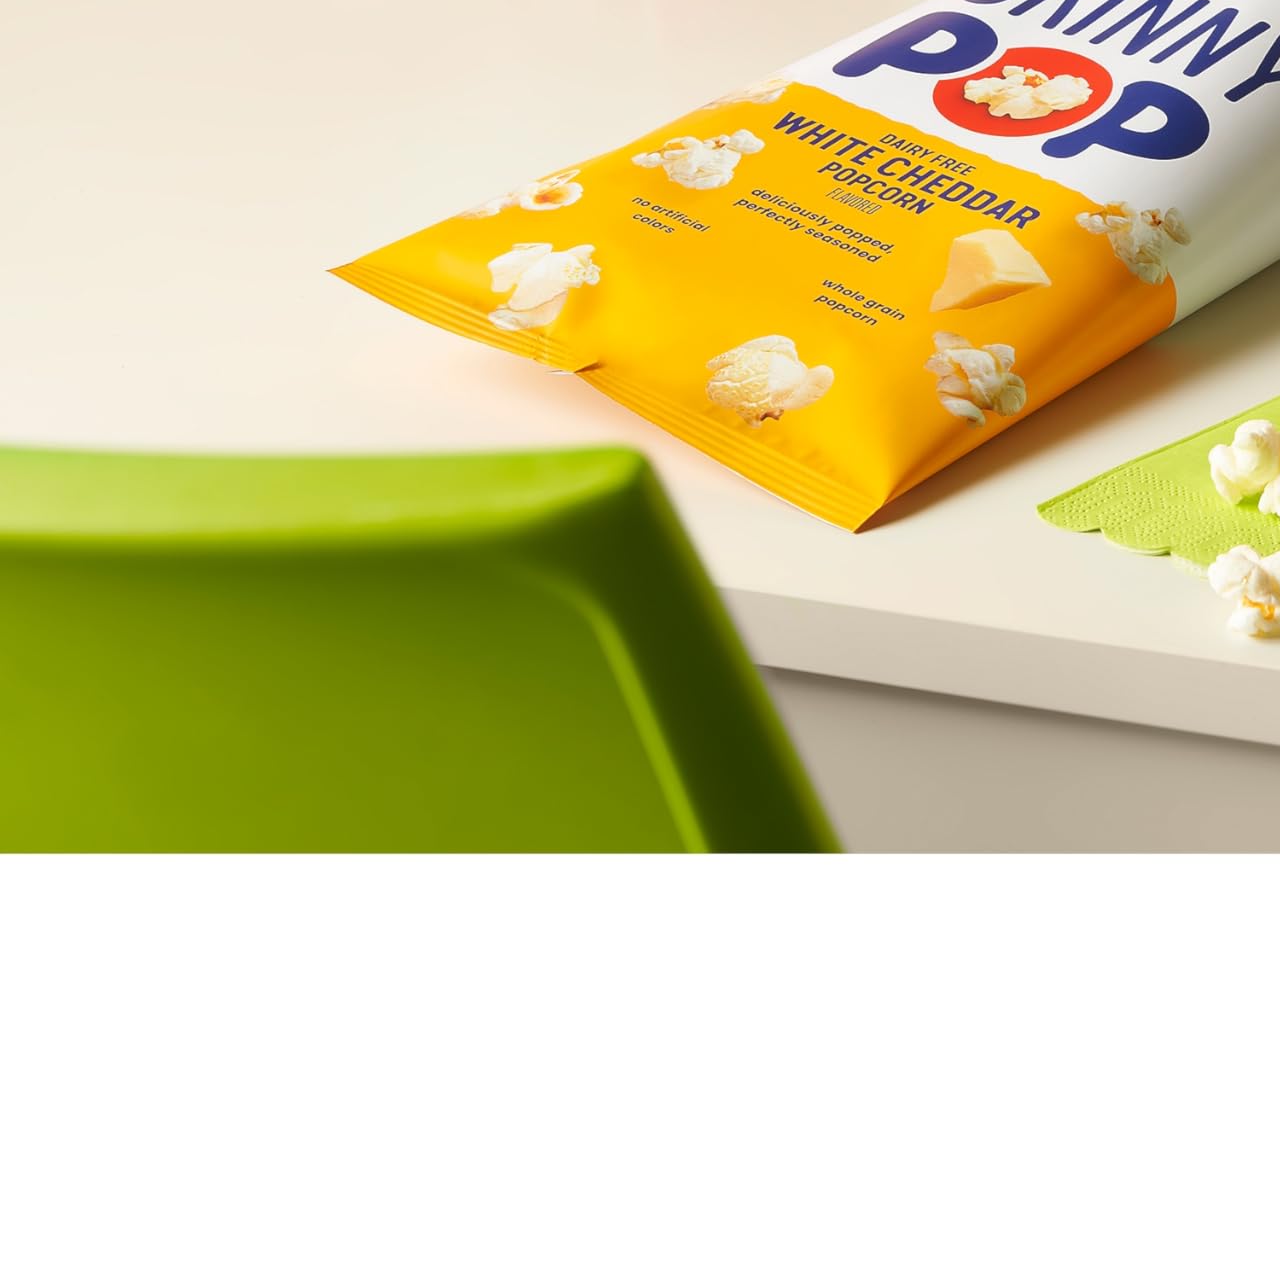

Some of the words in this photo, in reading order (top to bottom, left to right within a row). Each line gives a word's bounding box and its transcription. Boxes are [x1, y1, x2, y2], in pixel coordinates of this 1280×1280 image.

[832, 11, 1210, 160] POP
[773, 111, 885, 166] WHITE
[876, 156, 1041, 229] CHEDDAR
[879, 133, 932, 160] DAIRY
[929, 154, 976, 176] FREE
[817, 161, 935, 215] POPCORN
[826, 187, 883, 215] FLAVORED
[632, 196, 650, 207] no
[651, 204, 711, 232] artificial
[632, 212, 675, 234] colors
[734, 198, 805, 231] perfectly
[804, 226, 882, 263] seasoned
[751, 187, 833, 227] deliciously
[829, 222, 894, 254] popped,
[814, 293, 878, 326] popcorn
[822, 278, 865, 302] whole
[863, 298, 905, 321] grain
